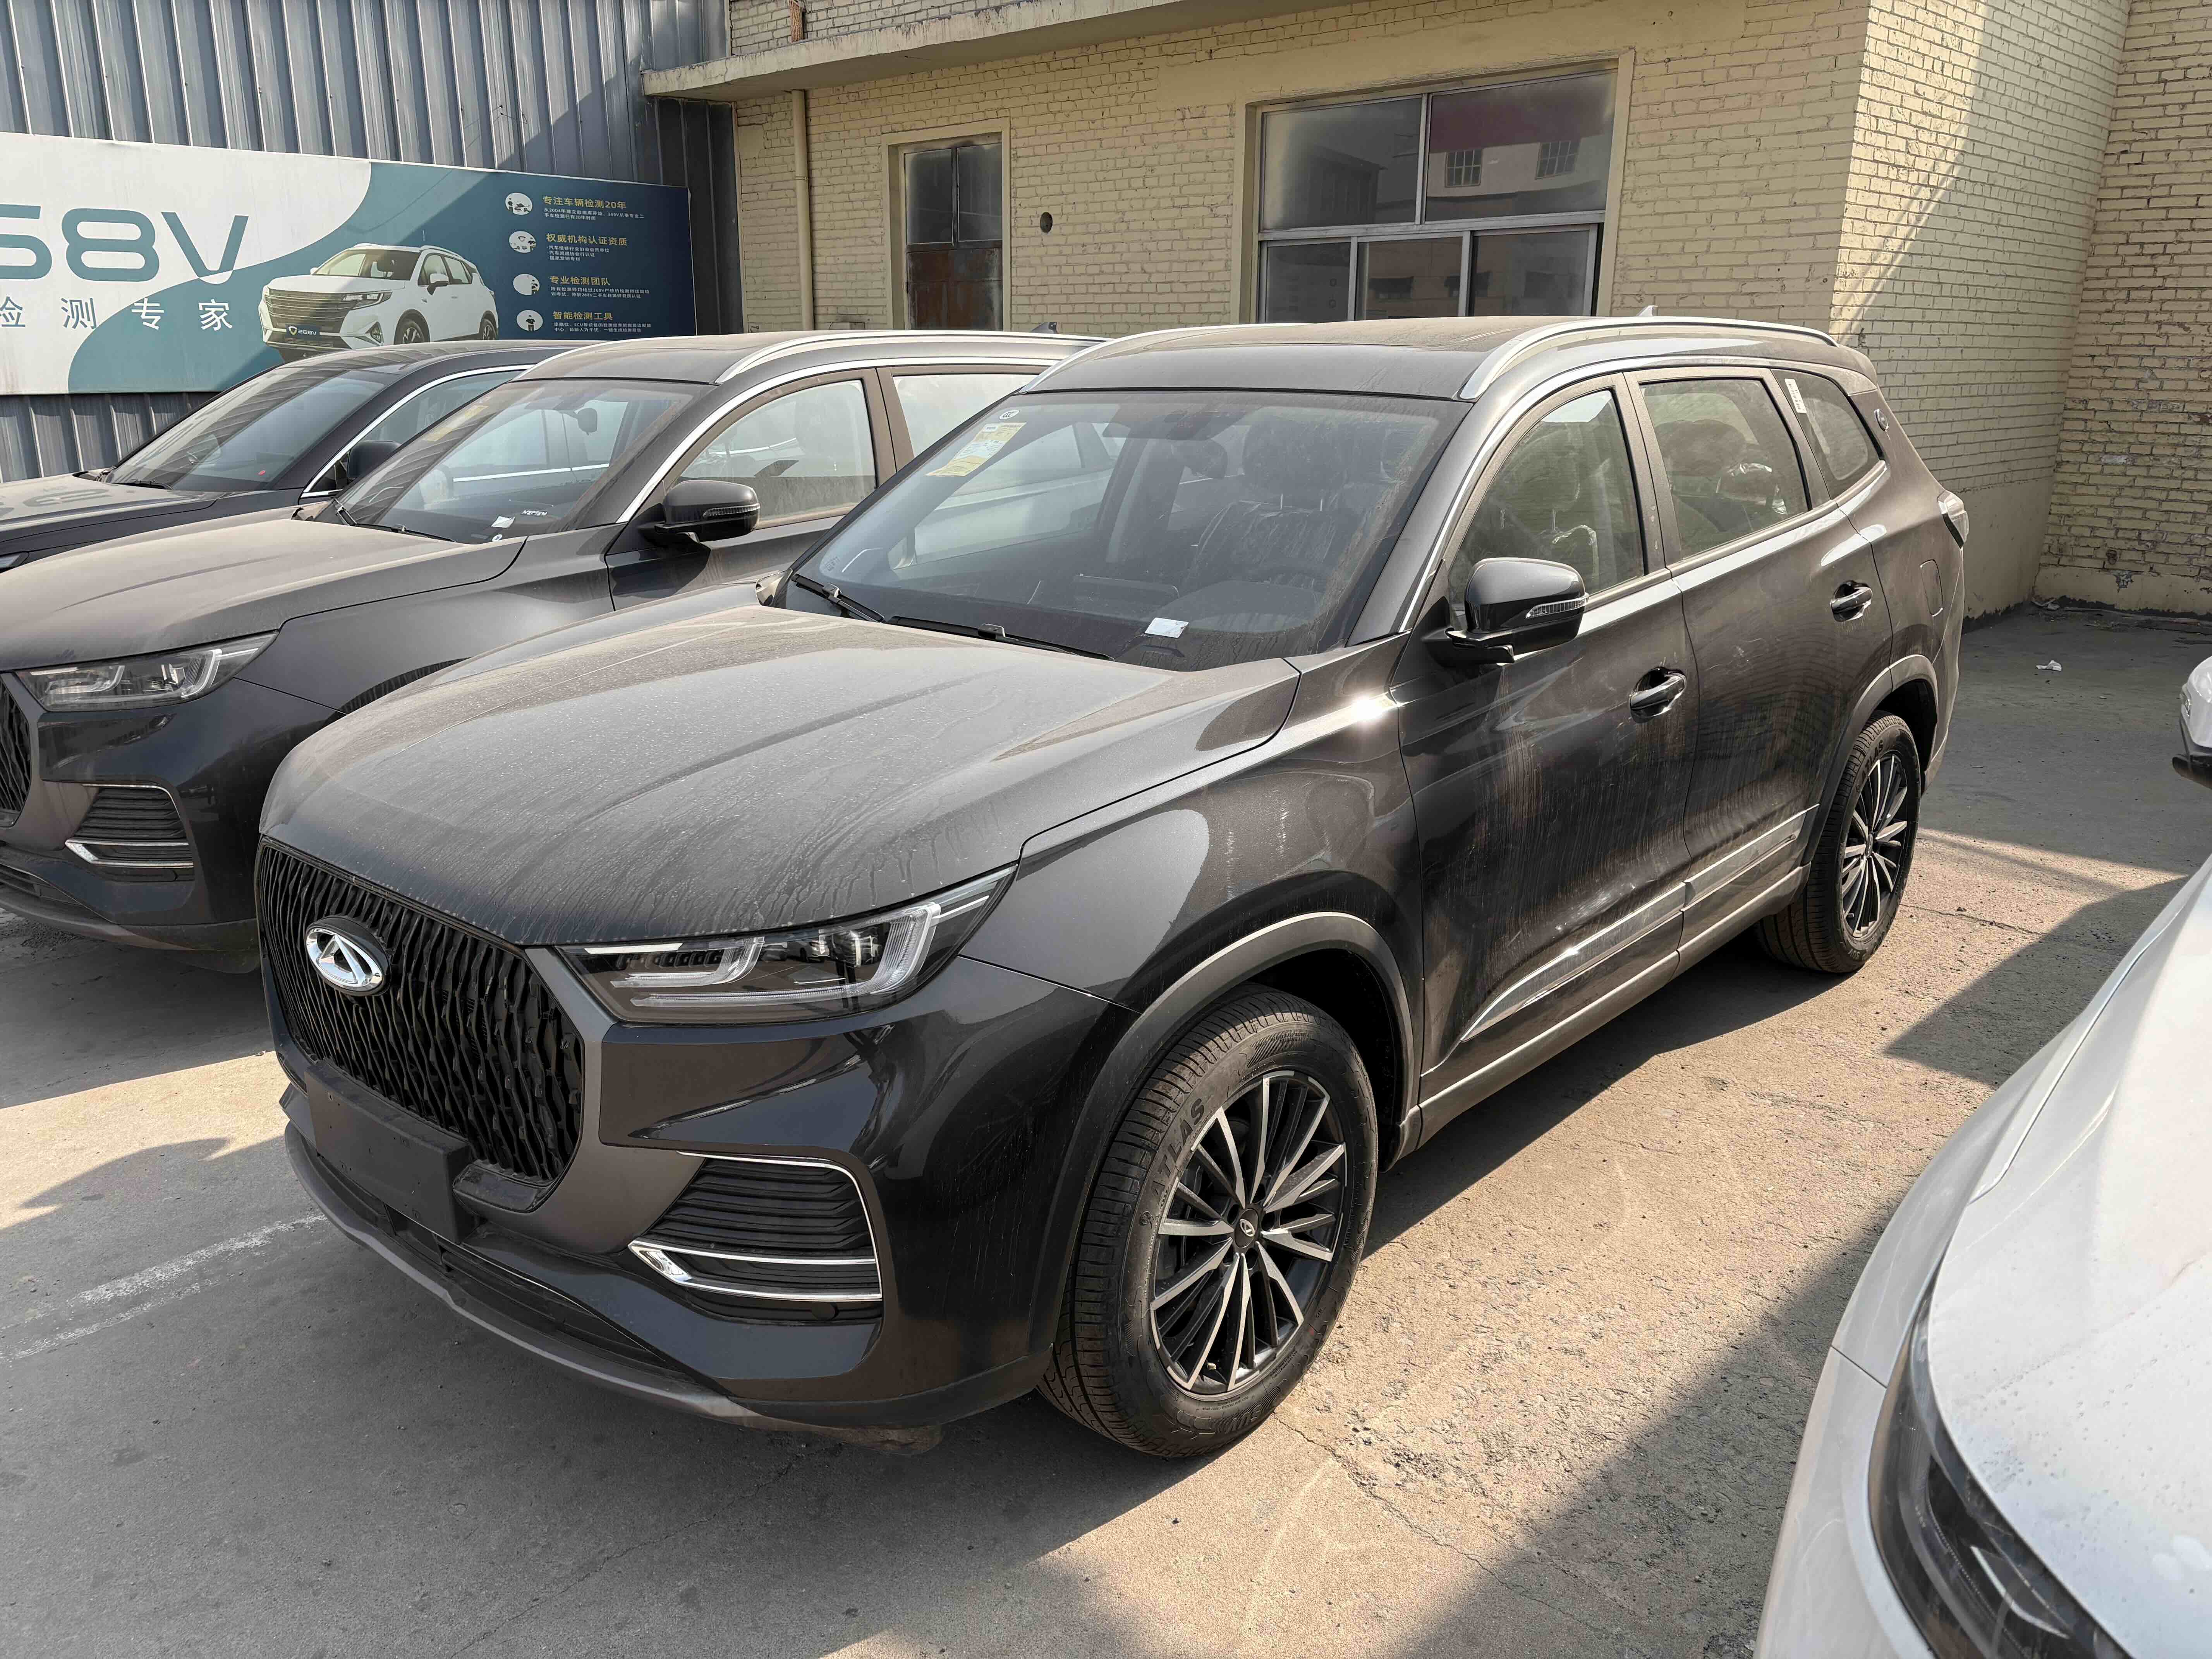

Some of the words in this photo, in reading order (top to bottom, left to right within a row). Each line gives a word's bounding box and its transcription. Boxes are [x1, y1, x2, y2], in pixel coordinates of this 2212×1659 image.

[543, 196, 626, 209] 专注车辆检测20年
[546, 233, 627, 246] 权威机构认证资质
[550, 276, 611, 285] 专业检测团队
[0, 296, 233, 331] 检测专家
[553, 311, 613, 321] 智能检测工具
[1152, 1098, 1204, 1197] ATLAS
